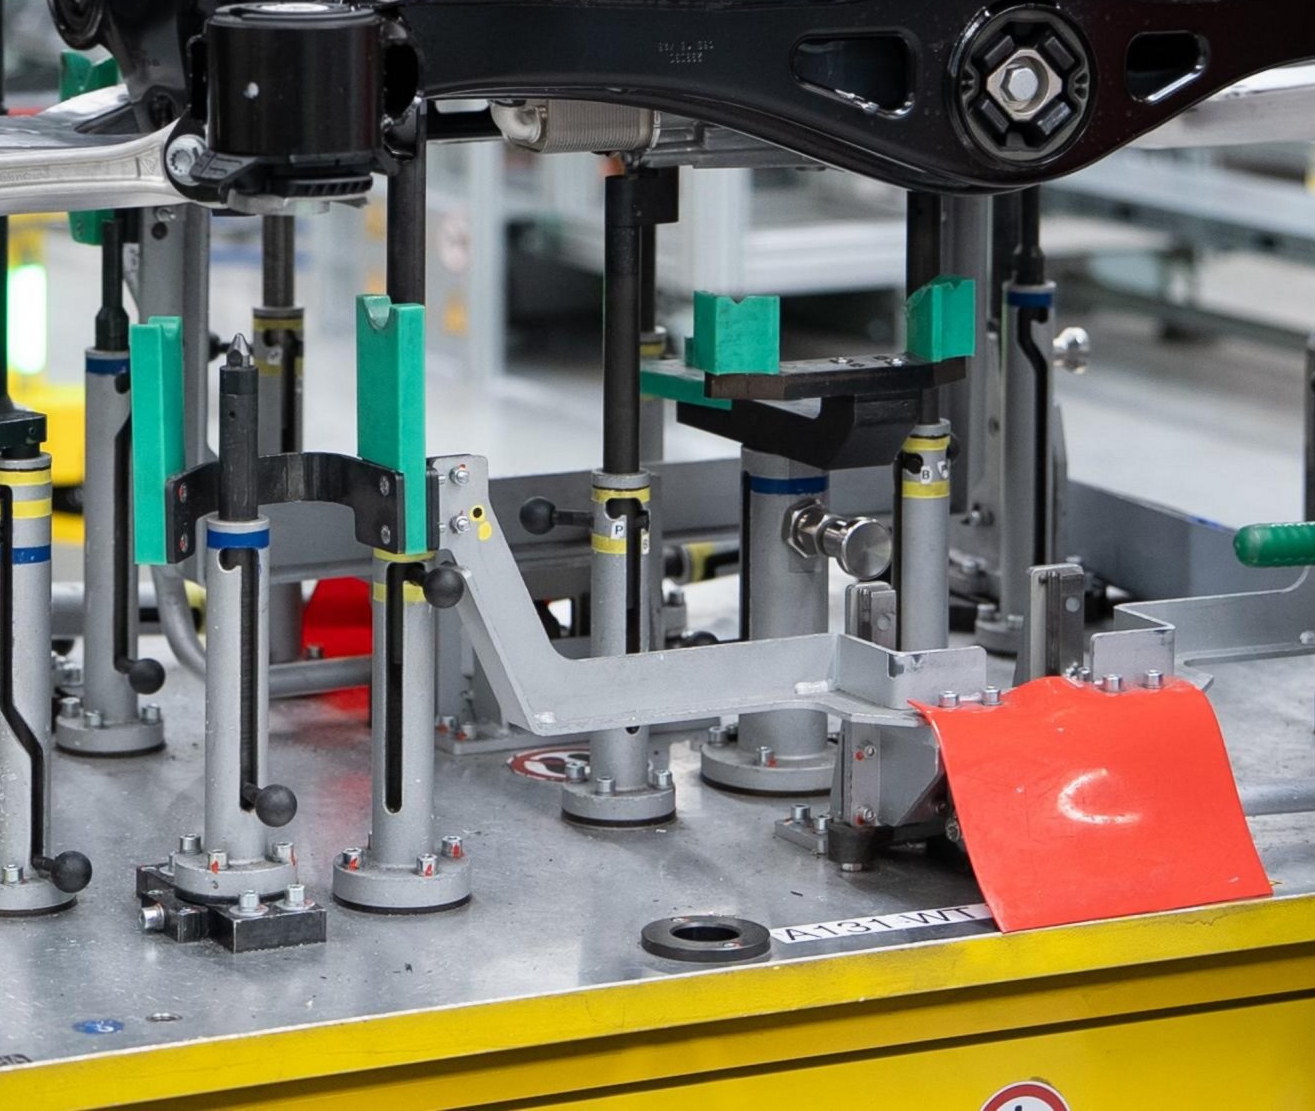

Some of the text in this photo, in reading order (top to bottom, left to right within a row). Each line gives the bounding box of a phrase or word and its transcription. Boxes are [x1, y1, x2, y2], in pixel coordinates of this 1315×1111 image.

[922, 469, 930, 480] B
[615, 524, 623, 535] P
[784, 917, 893, 941] A131
